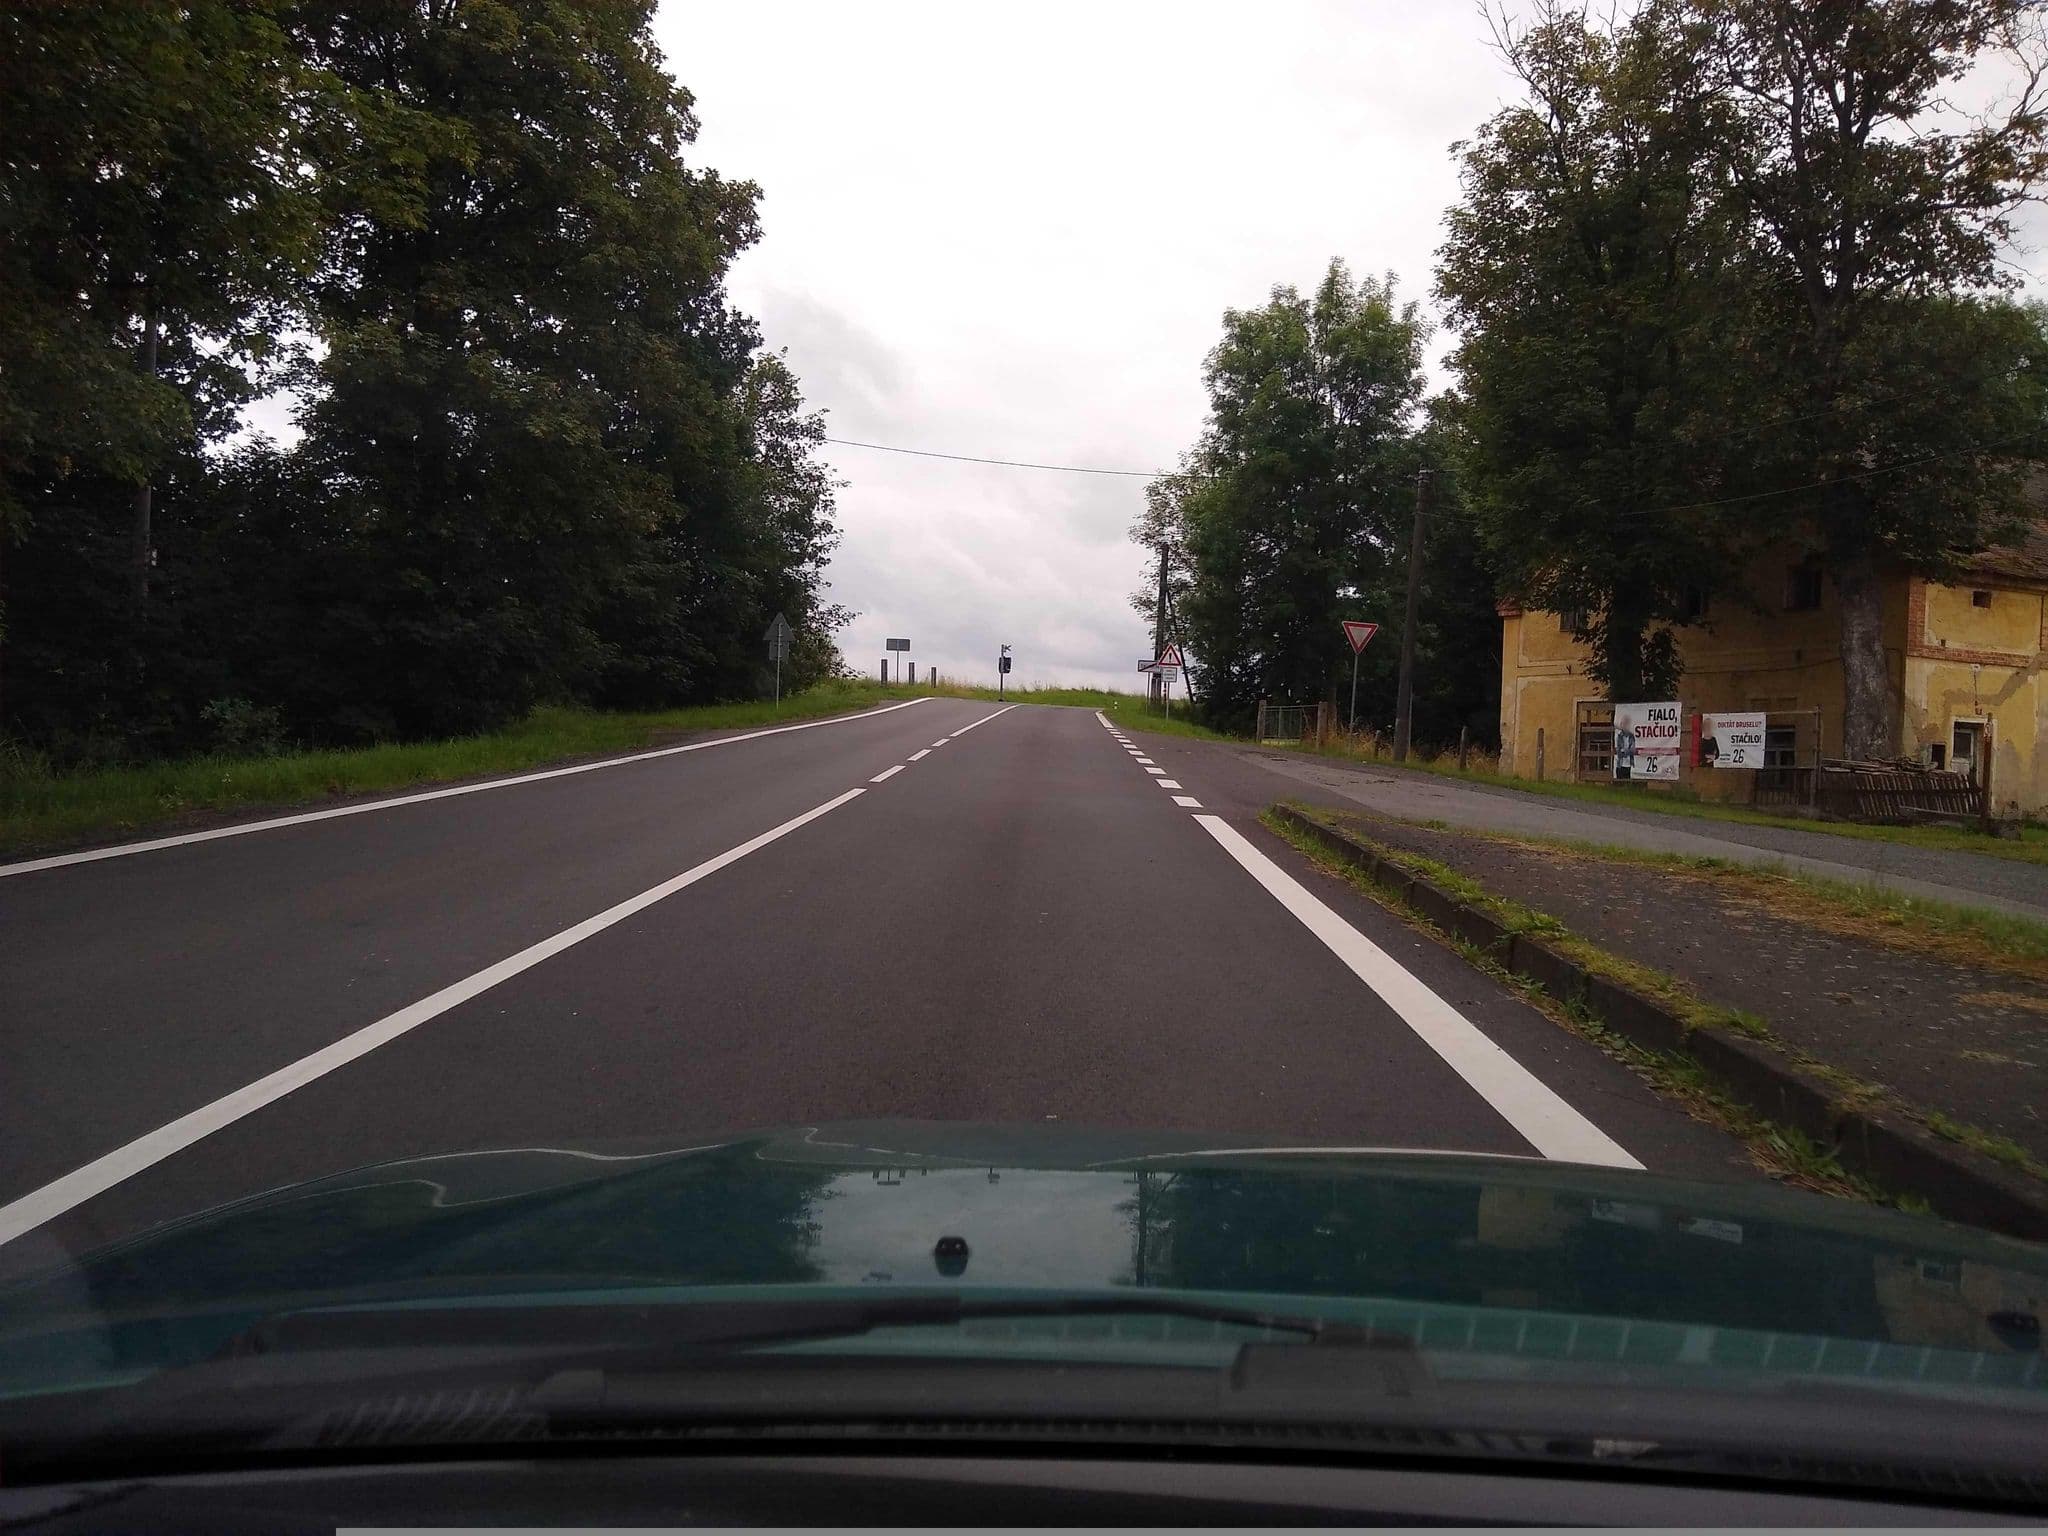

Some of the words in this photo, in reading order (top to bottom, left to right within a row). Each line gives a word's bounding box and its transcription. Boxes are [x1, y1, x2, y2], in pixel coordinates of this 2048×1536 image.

[1648, 708, 1678, 723] FIALO,
[1634, 722, 1678, 738] STAČILO!
[1730, 732, 1762, 744] STAČILO!
[1733, 748, 1745, 764] 26
[1646, 756, 1658, 773] 26
